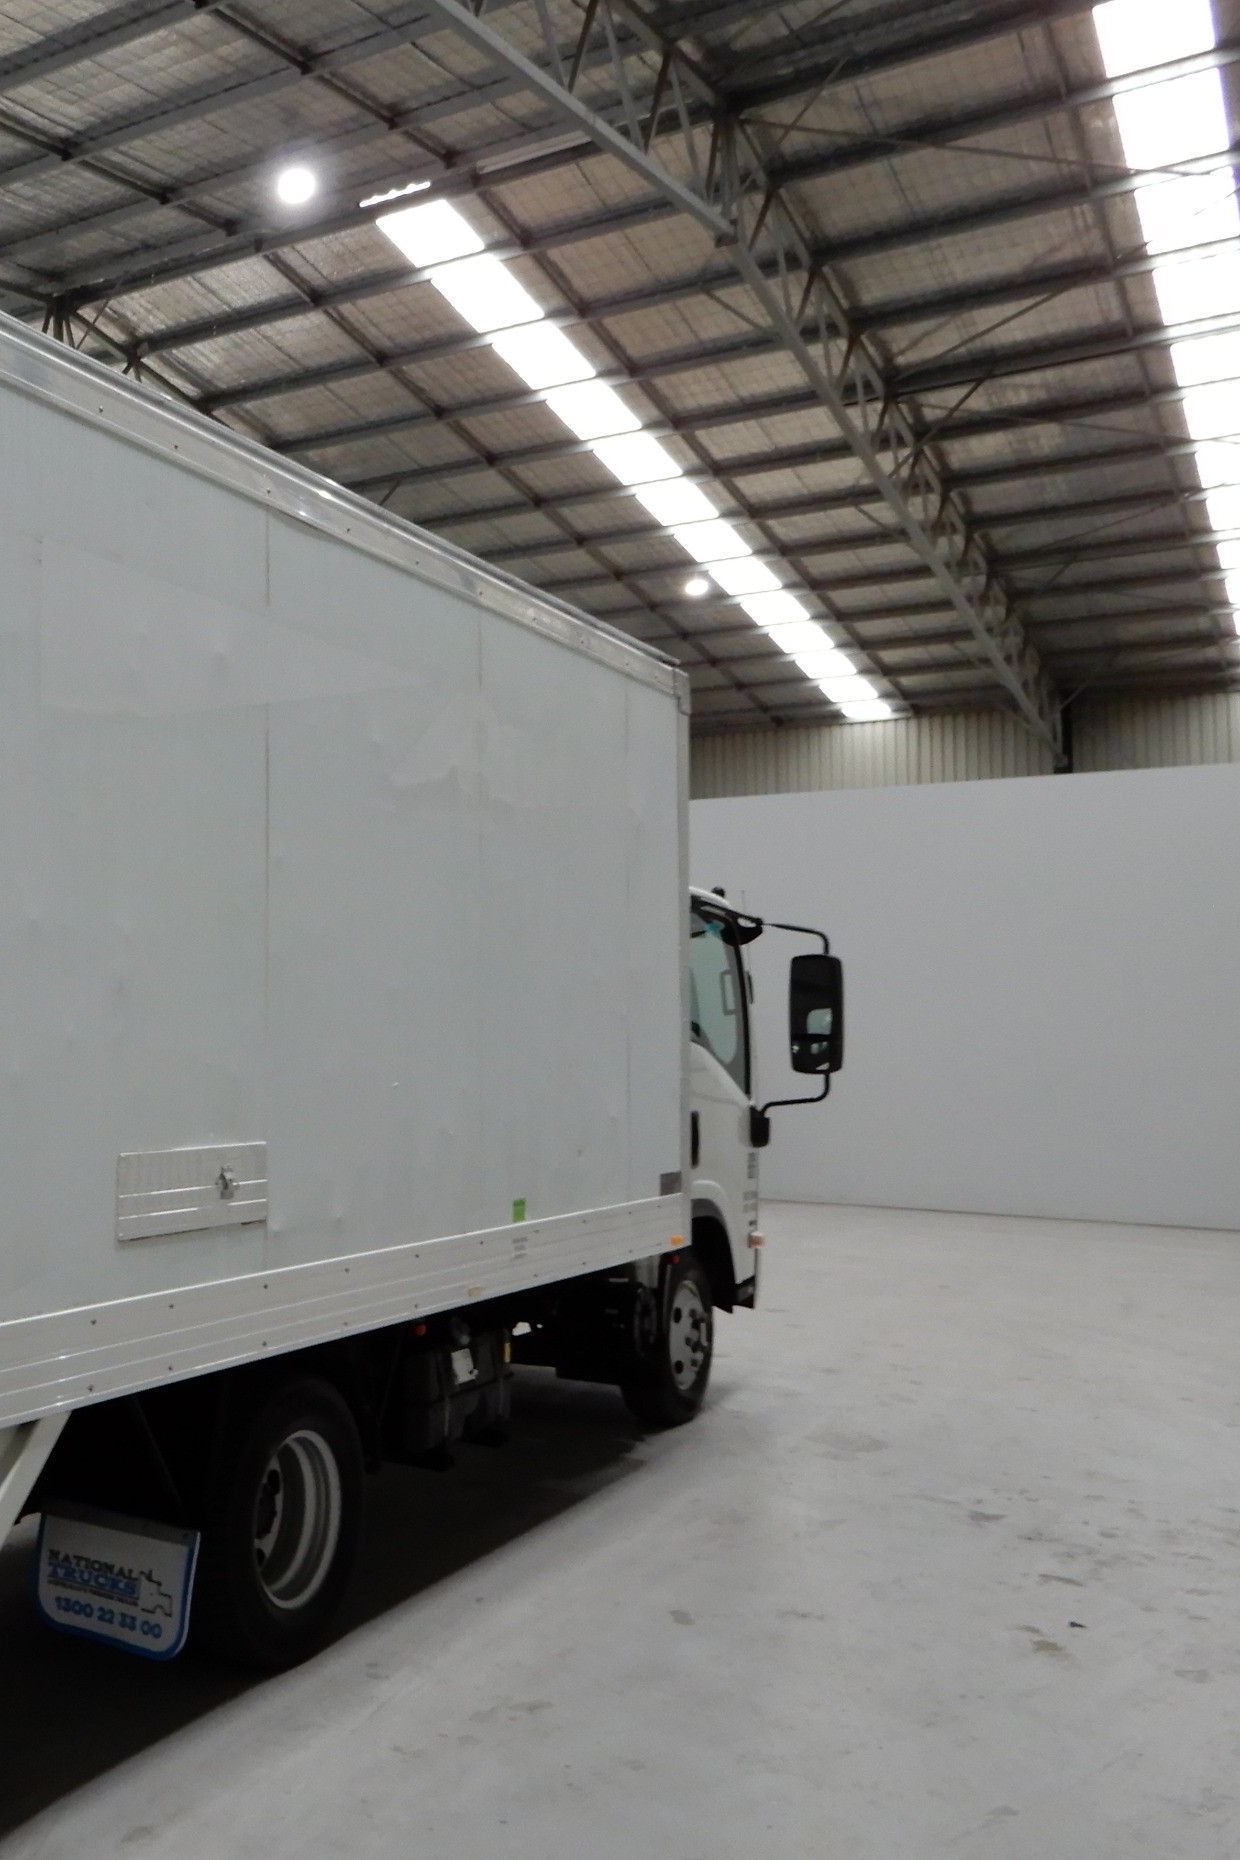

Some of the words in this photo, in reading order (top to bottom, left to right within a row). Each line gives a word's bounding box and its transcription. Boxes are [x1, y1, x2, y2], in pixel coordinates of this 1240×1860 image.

[48, 1549, 139, 1580] NATIONAL
[48, 1563, 137, 1595] TRUCKS
[55, 1596, 94, 1618] 1300
[97, 1606, 115, 1625] 22
[141, 1620, 163, 1640] 00
